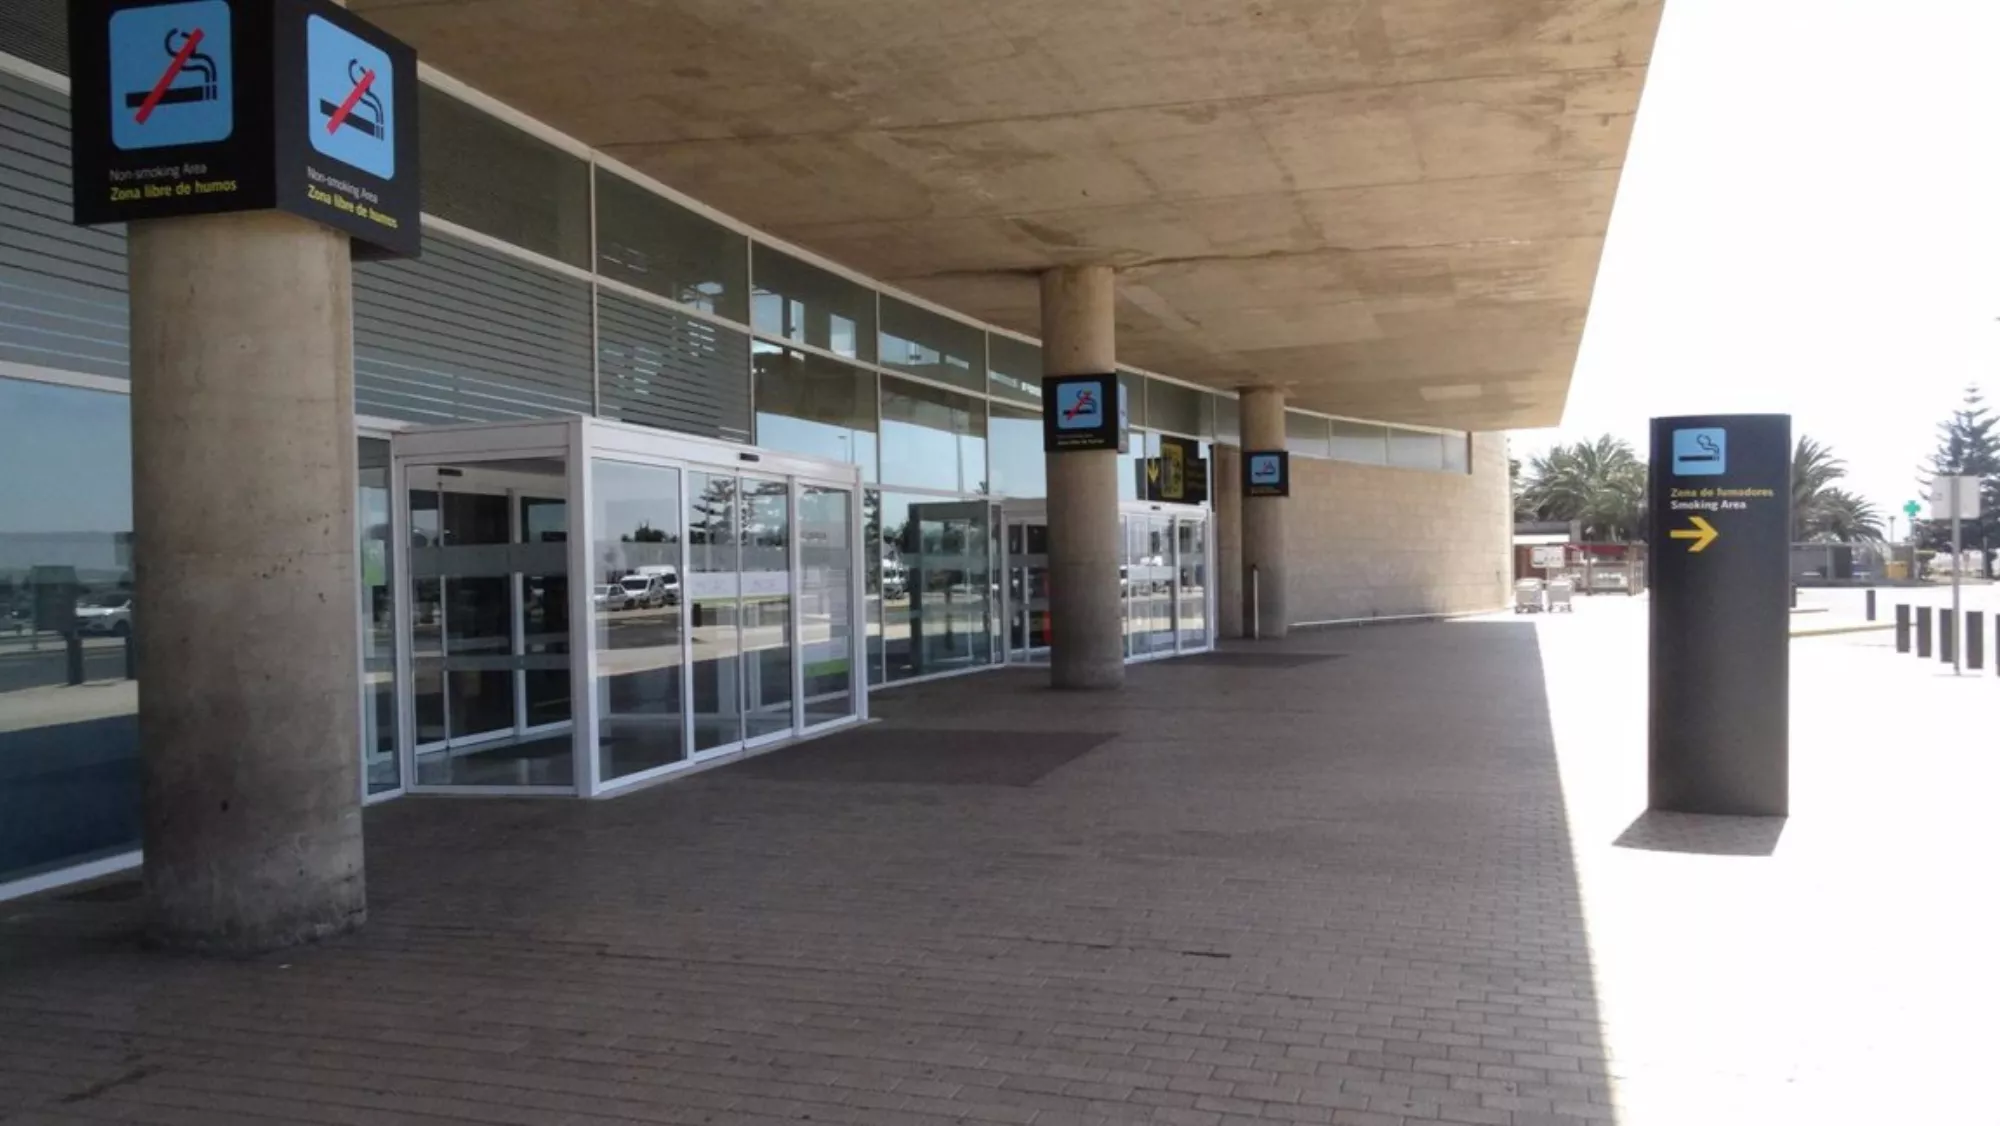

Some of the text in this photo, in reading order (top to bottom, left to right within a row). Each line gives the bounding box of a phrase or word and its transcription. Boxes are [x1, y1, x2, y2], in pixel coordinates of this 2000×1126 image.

[109, 163, 208, 182] Non-smoking Area
[110, 180, 238, 201] Zona libre de humos
[360, 187, 379, 204] Area
[307, 183, 332, 205] Zona
[333, 193, 354, 213] libre
[355, 203, 368, 218] de
[1670, 487, 1775, 498] Zona de fumadores
[1670, 499, 1747, 511] Smoking Area
